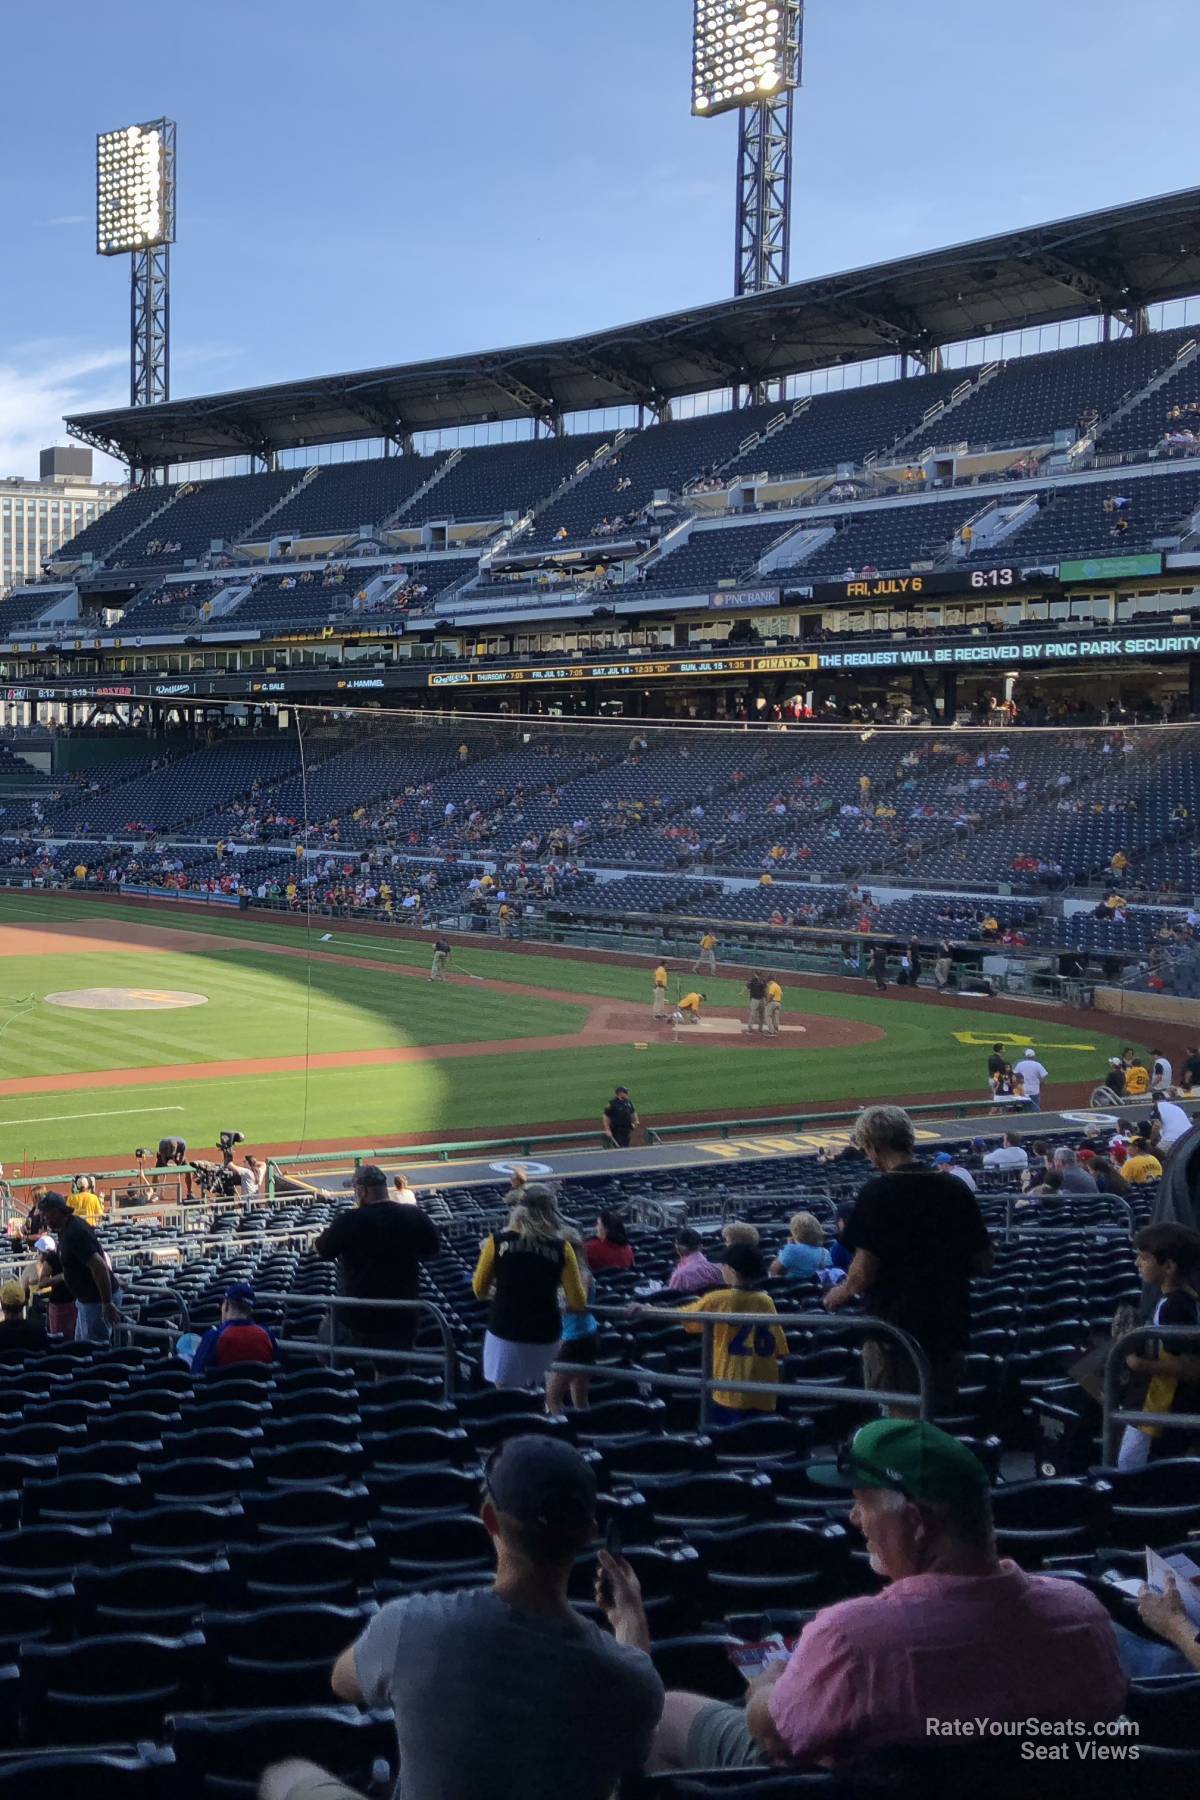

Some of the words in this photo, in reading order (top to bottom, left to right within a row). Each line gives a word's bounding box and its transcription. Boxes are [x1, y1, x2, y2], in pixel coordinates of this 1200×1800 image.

[846, 583, 870, 597] FRI,
[873, 580, 906, 595] JULY
[912, 577, 922, 591] 6
[971, 568, 1013, 587] 6:13
[724, 592, 747, 605] PNC
[749, 590, 776, 603] BANK
[819, 654, 842, 667] THE
[844, 652, 898, 666] REQUEST
[901, 650, 934, 663] WILL
[935, 649, 953, 662] BE
[955, 646, 1020, 661] RECEIVED
[1023, 645, 1042, 659] BY
[1046, 643, 1078, 657] PNC
[1080, 640, 1122, 656] PARK
[1125, 636, 1200, 653] SECURITY
[353, 679, 385, 688] HAMMEL
